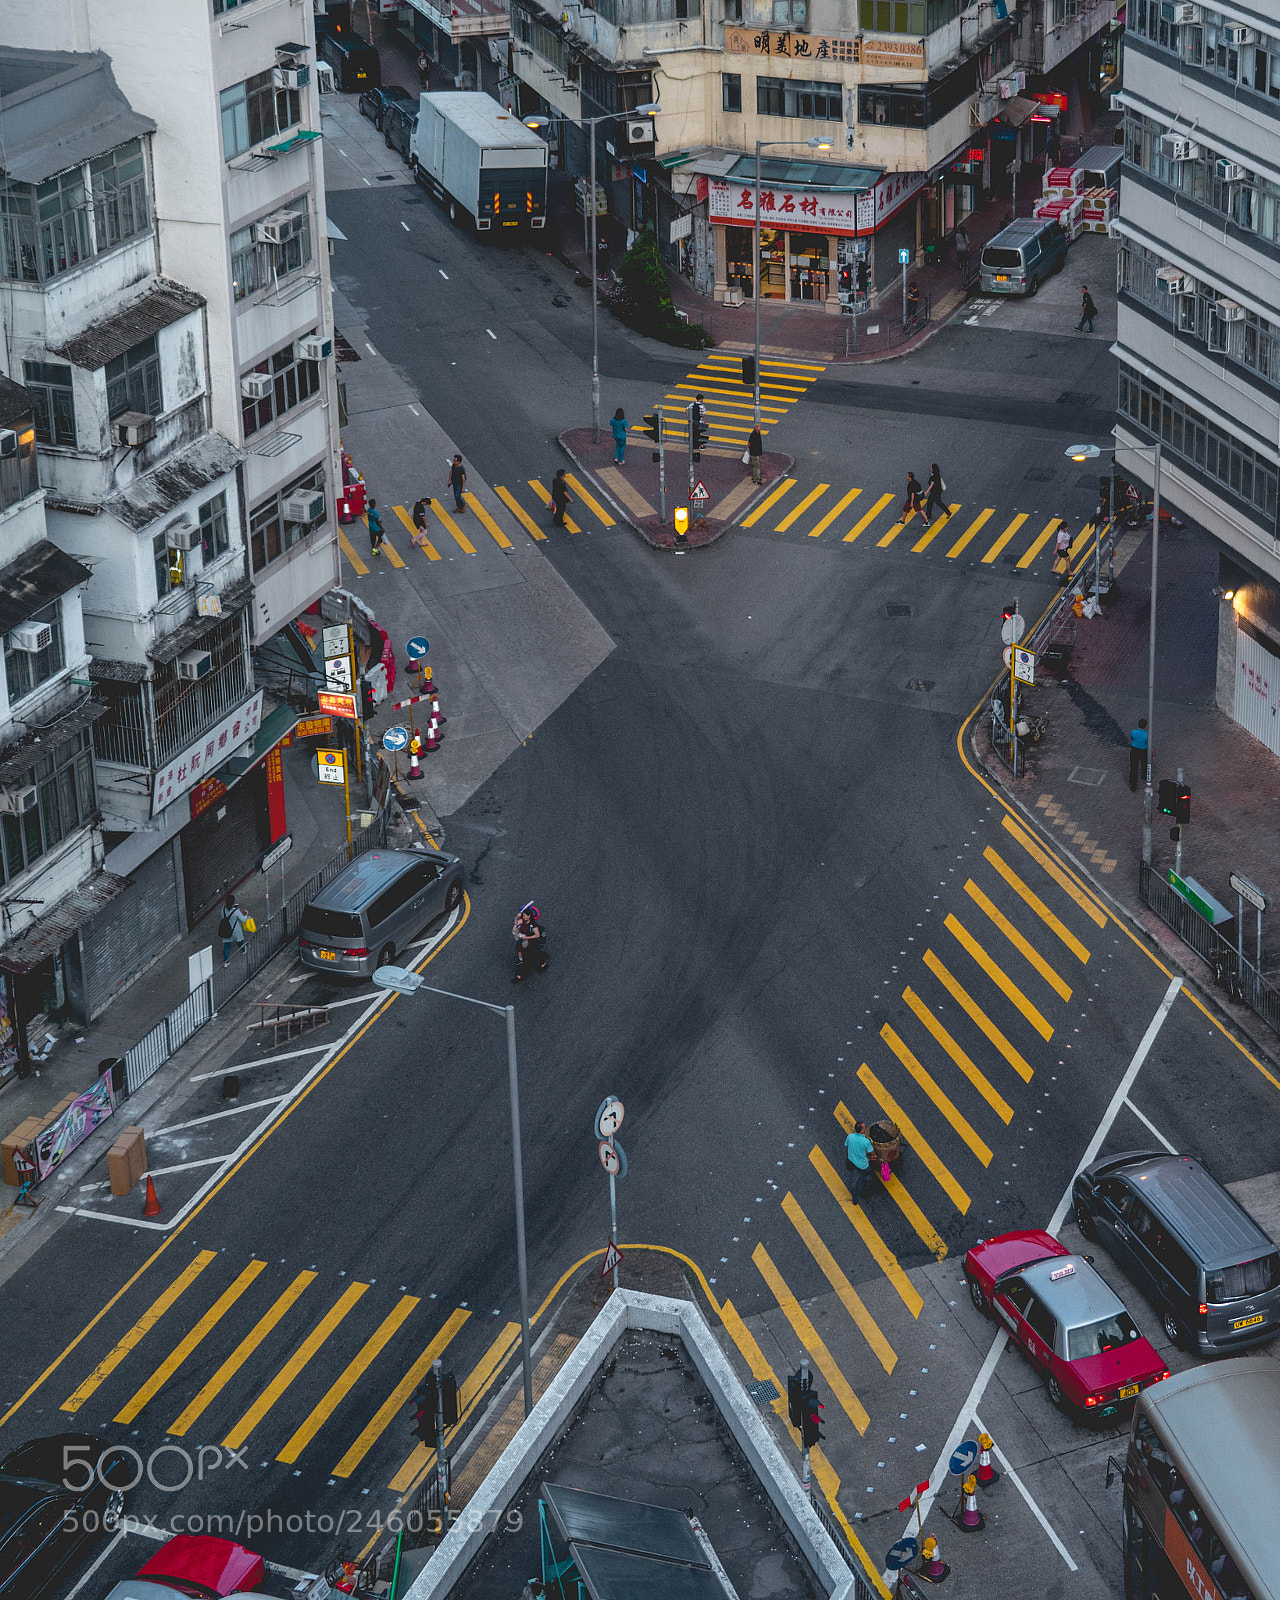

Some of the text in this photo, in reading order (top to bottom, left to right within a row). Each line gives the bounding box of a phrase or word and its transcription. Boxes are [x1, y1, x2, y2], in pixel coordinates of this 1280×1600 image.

[754, 31, 831, 60] 明美地產
[877, 41, 898, 52] 2393
[819, 208, 852, 219] 有限公司
